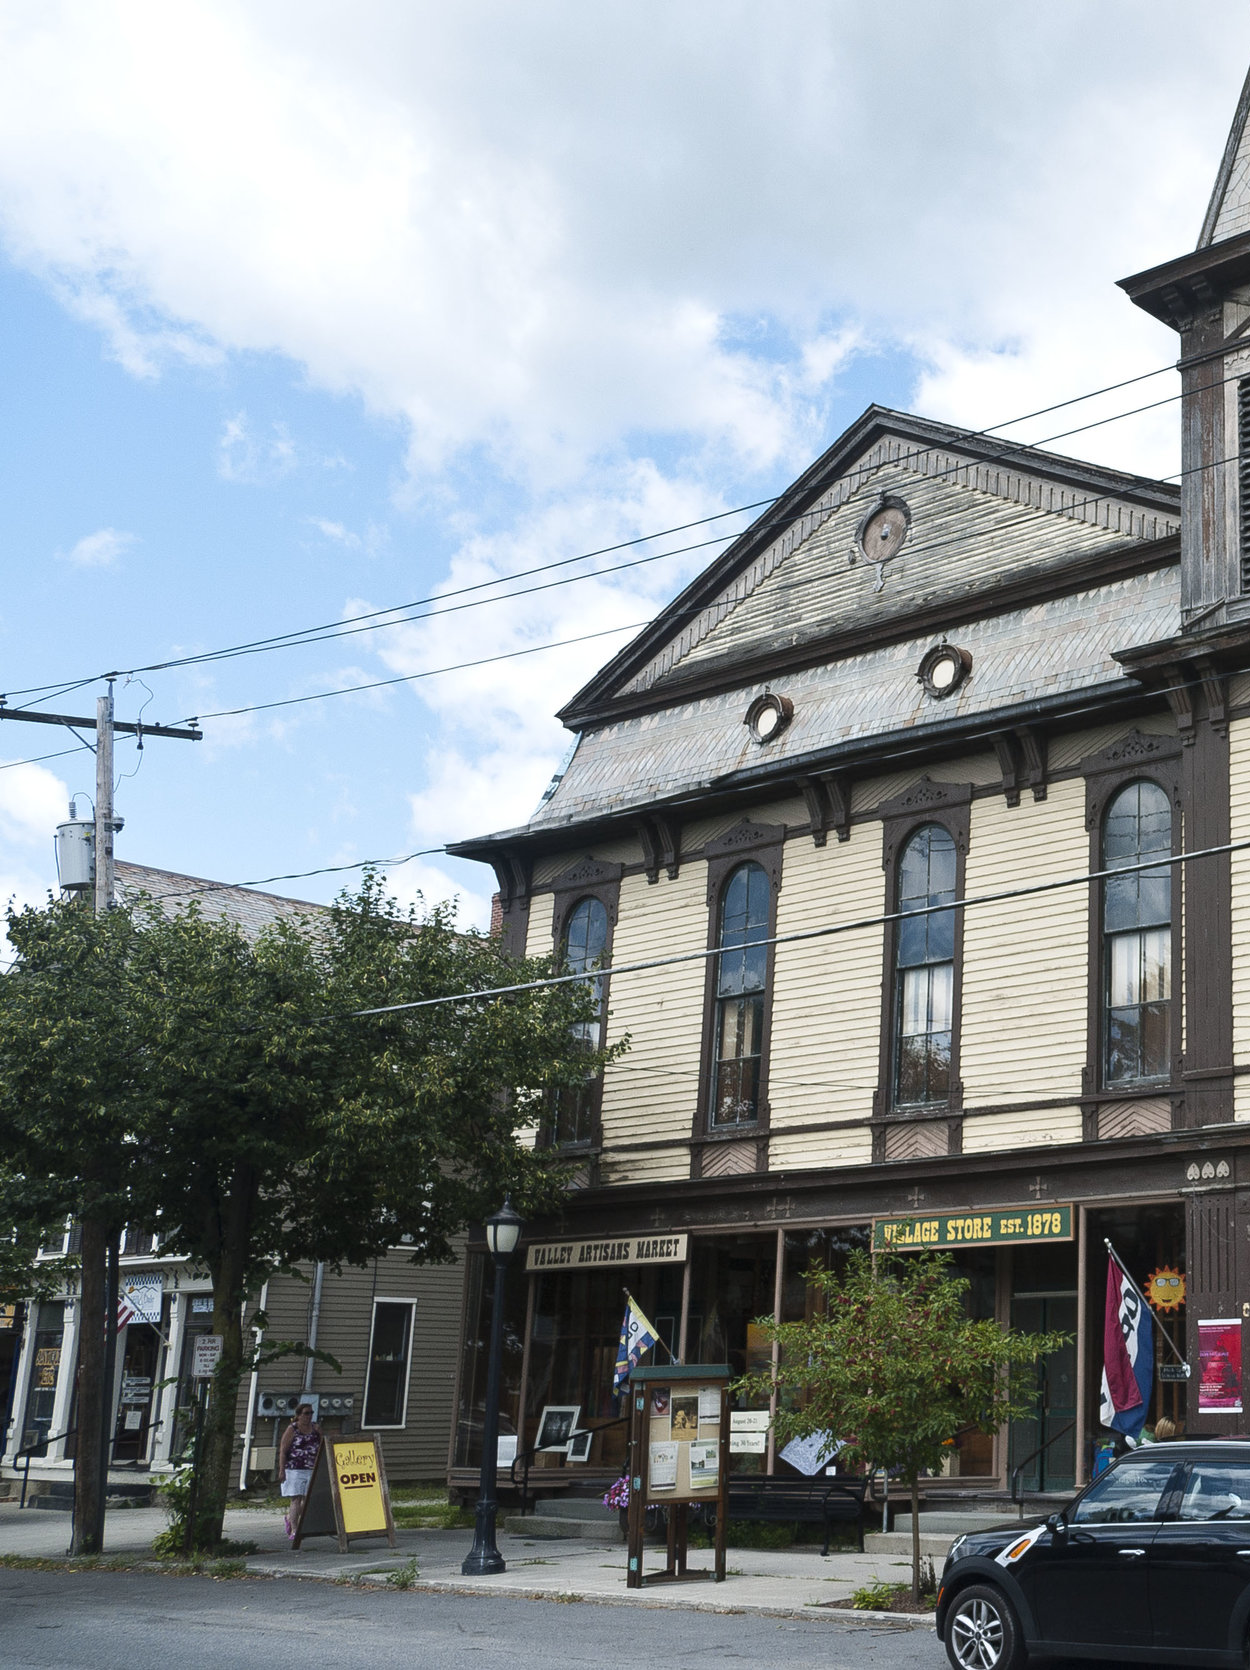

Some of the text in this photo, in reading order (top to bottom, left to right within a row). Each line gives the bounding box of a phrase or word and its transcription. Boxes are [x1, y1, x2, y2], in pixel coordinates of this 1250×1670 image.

[884, 1212, 1062, 1244] VILLAGE STORE EST. 1878
[534, 1238, 680, 1266] VALLEY ARTISANS MARKET
[335, 1450, 375, 1470] Gallery
[340, 1472, 377, 1485] OPEN
